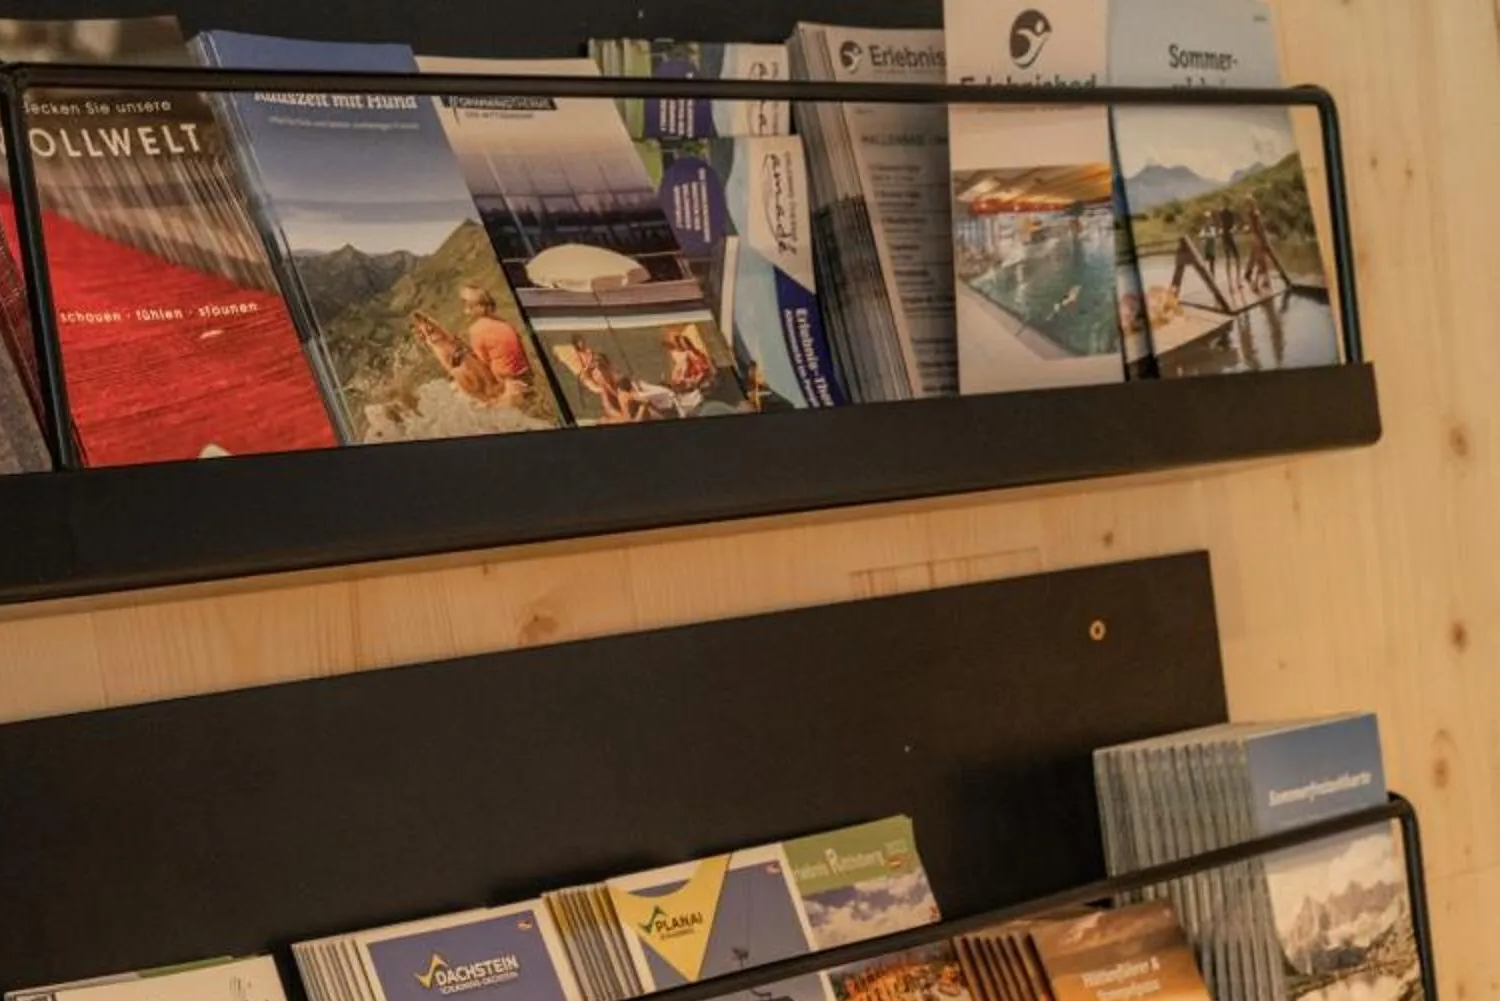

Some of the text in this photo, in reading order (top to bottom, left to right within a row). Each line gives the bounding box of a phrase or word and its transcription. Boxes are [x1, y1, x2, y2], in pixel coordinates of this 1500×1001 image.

[870, 45, 947, 69] Erlebnis
[1168, 43, 1239, 71] Sommer-
[85, 101, 110, 115] Sie
[116, 100, 172, 114] unsere
[332, 94, 364, 109] mit
[367, 95, 419, 110] Hund
[59, 301, 258, 323] schauen fühlen staunen
[435, 953, 520, 987] DACHSTEIN
